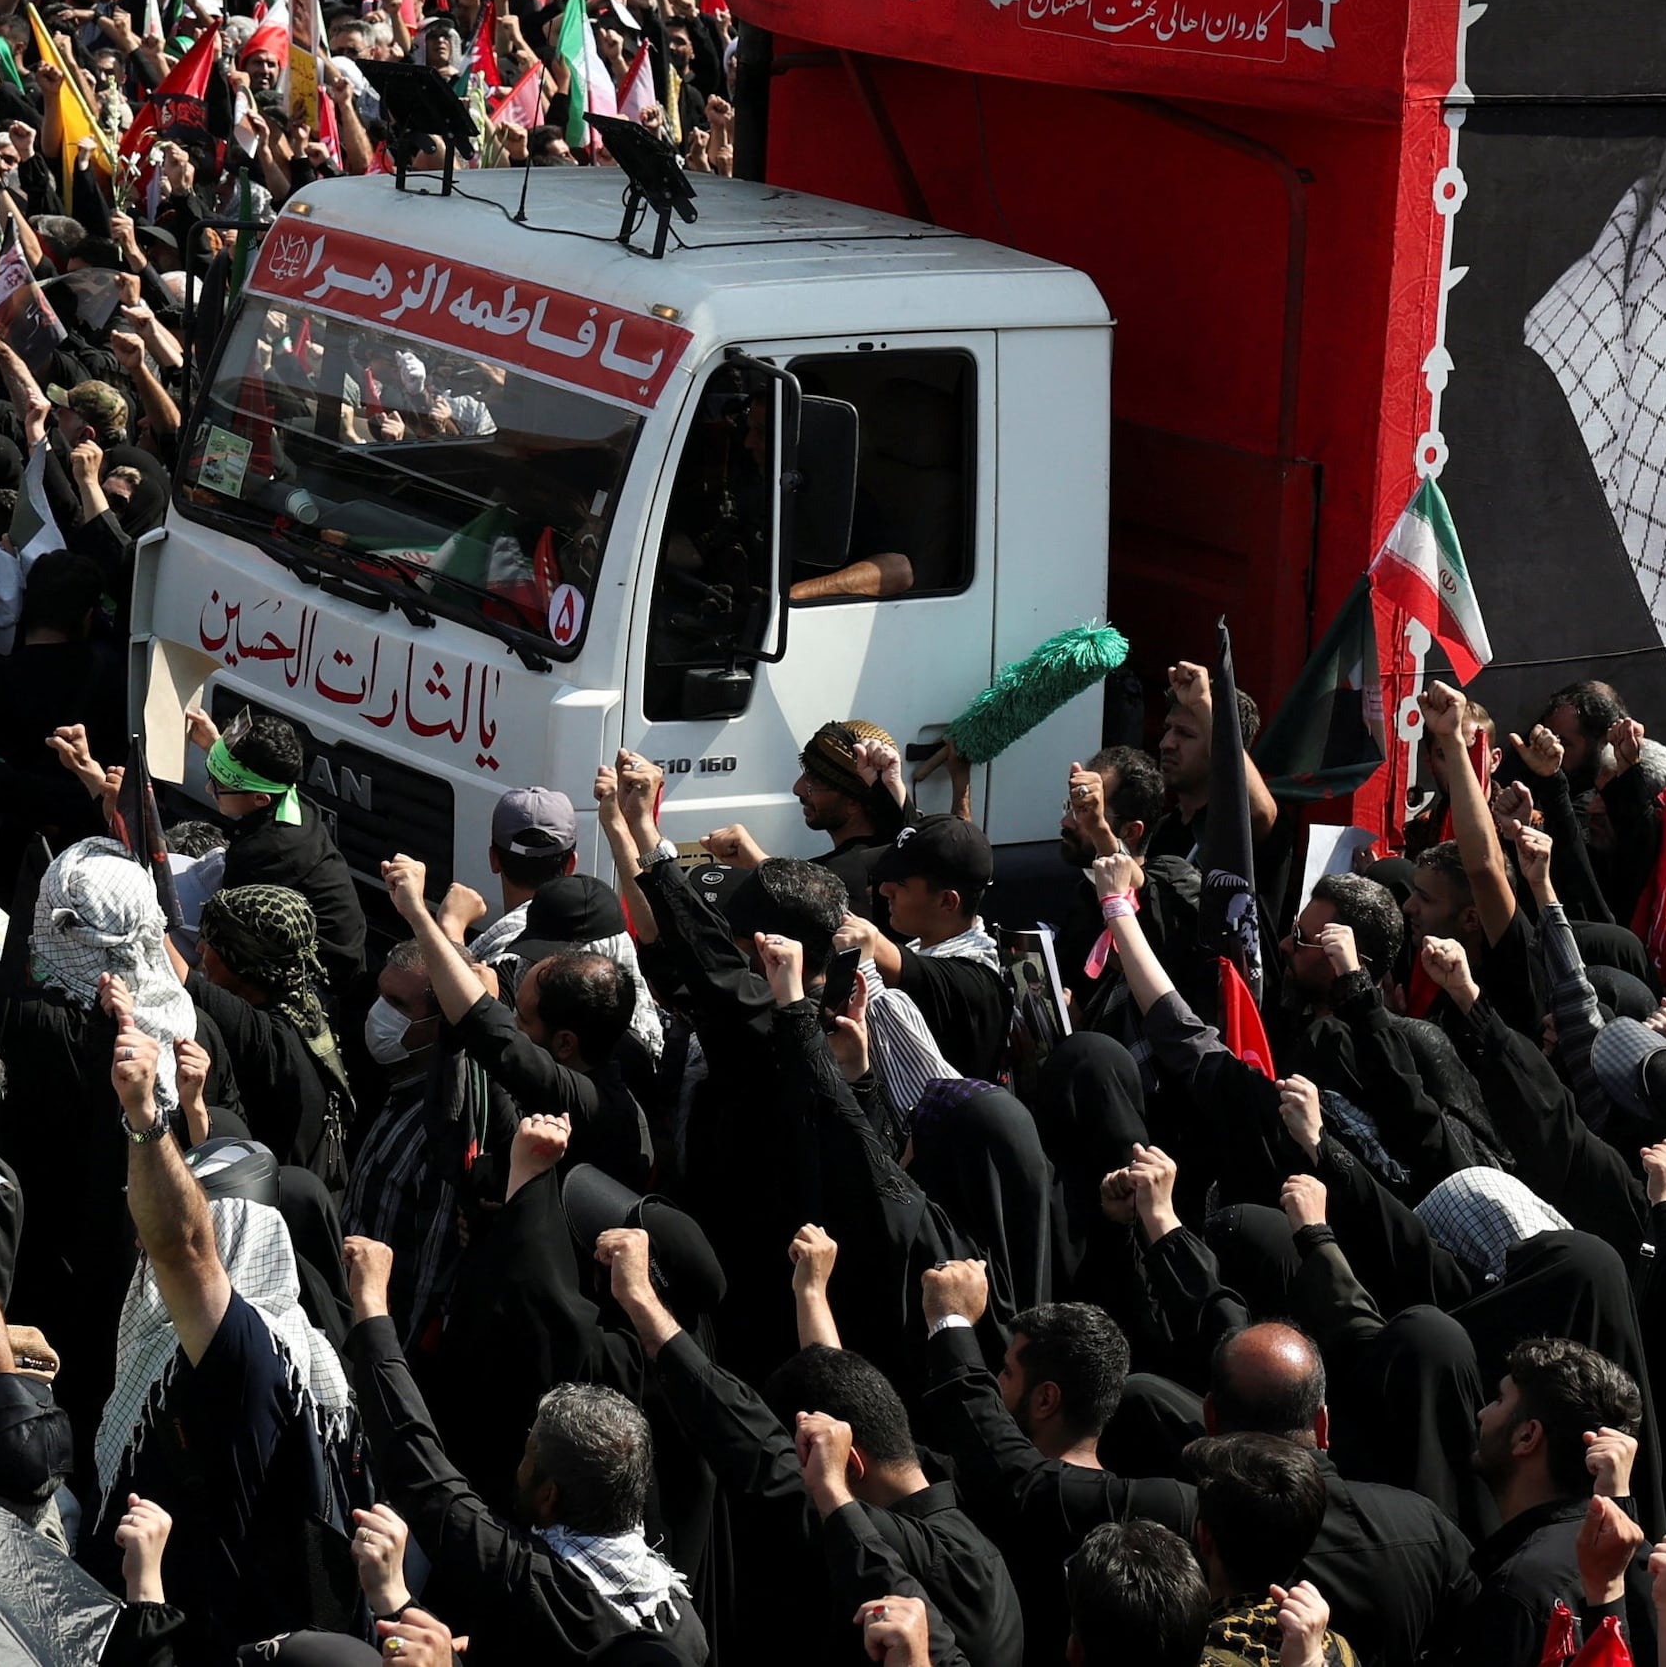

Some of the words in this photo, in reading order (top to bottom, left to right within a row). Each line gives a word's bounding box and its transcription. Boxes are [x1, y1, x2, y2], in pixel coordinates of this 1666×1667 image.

[1154, 0, 1206, 43] اهالی
[1205, 0, 1282, 44] کاروان
[301, 234, 453, 322] الزهرا
[448, 284, 597, 358] فاطمه
[597, 317, 665, 395] یا
[199, 588, 318, 691] الحسین
[299, 754, 373, 812] AN
[699, 756, 738, 773] 160
